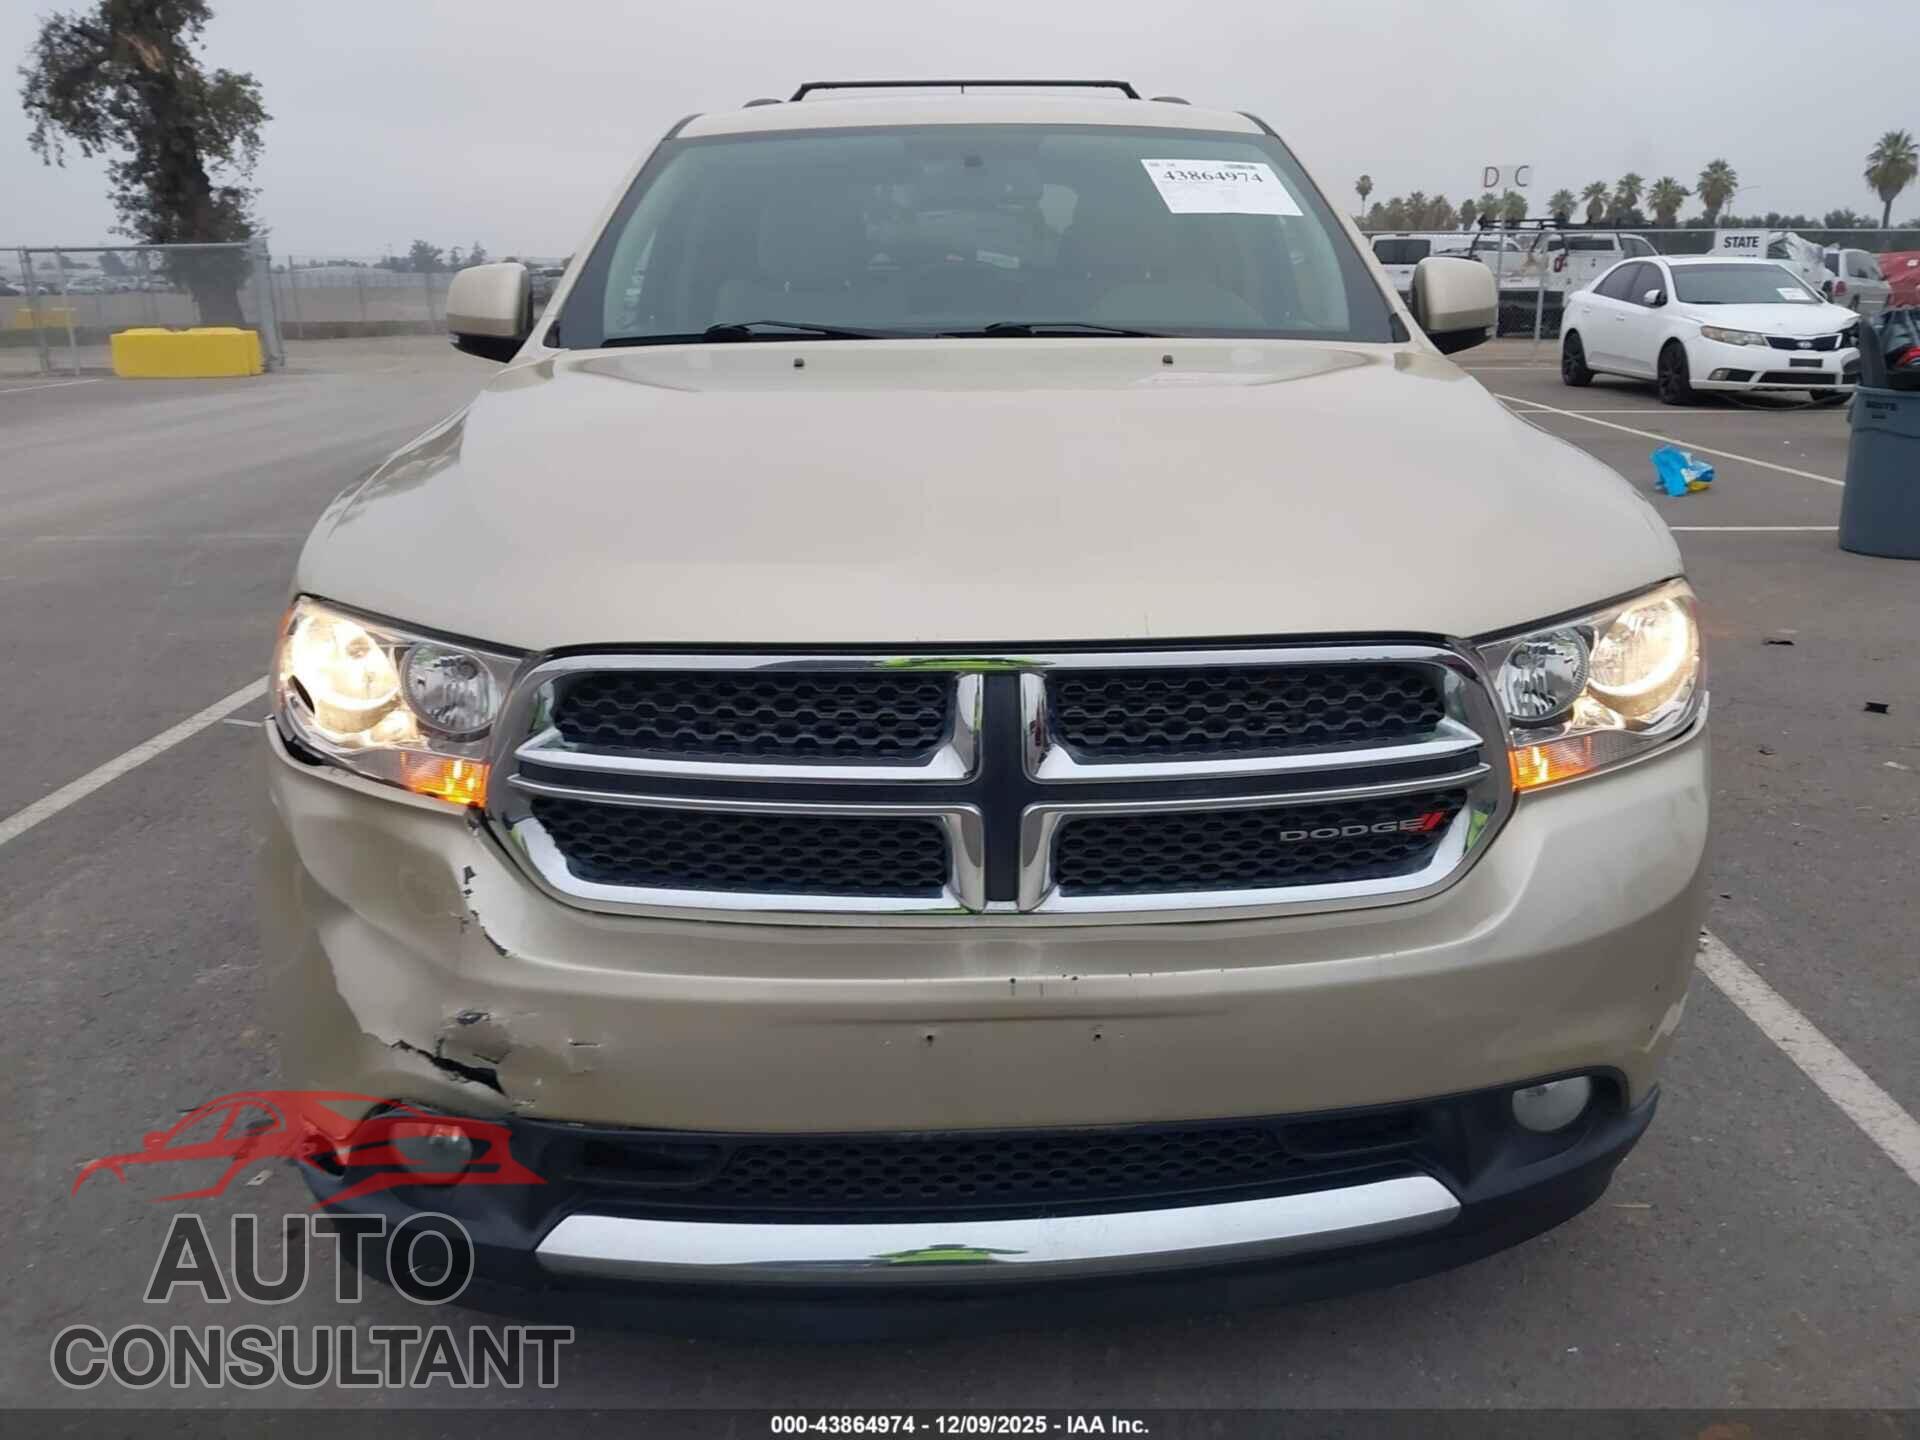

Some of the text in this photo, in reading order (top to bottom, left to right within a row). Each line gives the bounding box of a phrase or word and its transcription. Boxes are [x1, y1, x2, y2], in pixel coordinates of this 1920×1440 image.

[1164, 169, 1264, 183] 43864974
[1483, 165, 1530, 188] D C
[1723, 234, 1760, 249] STATE
[1279, 817, 1424, 842] DODGE
